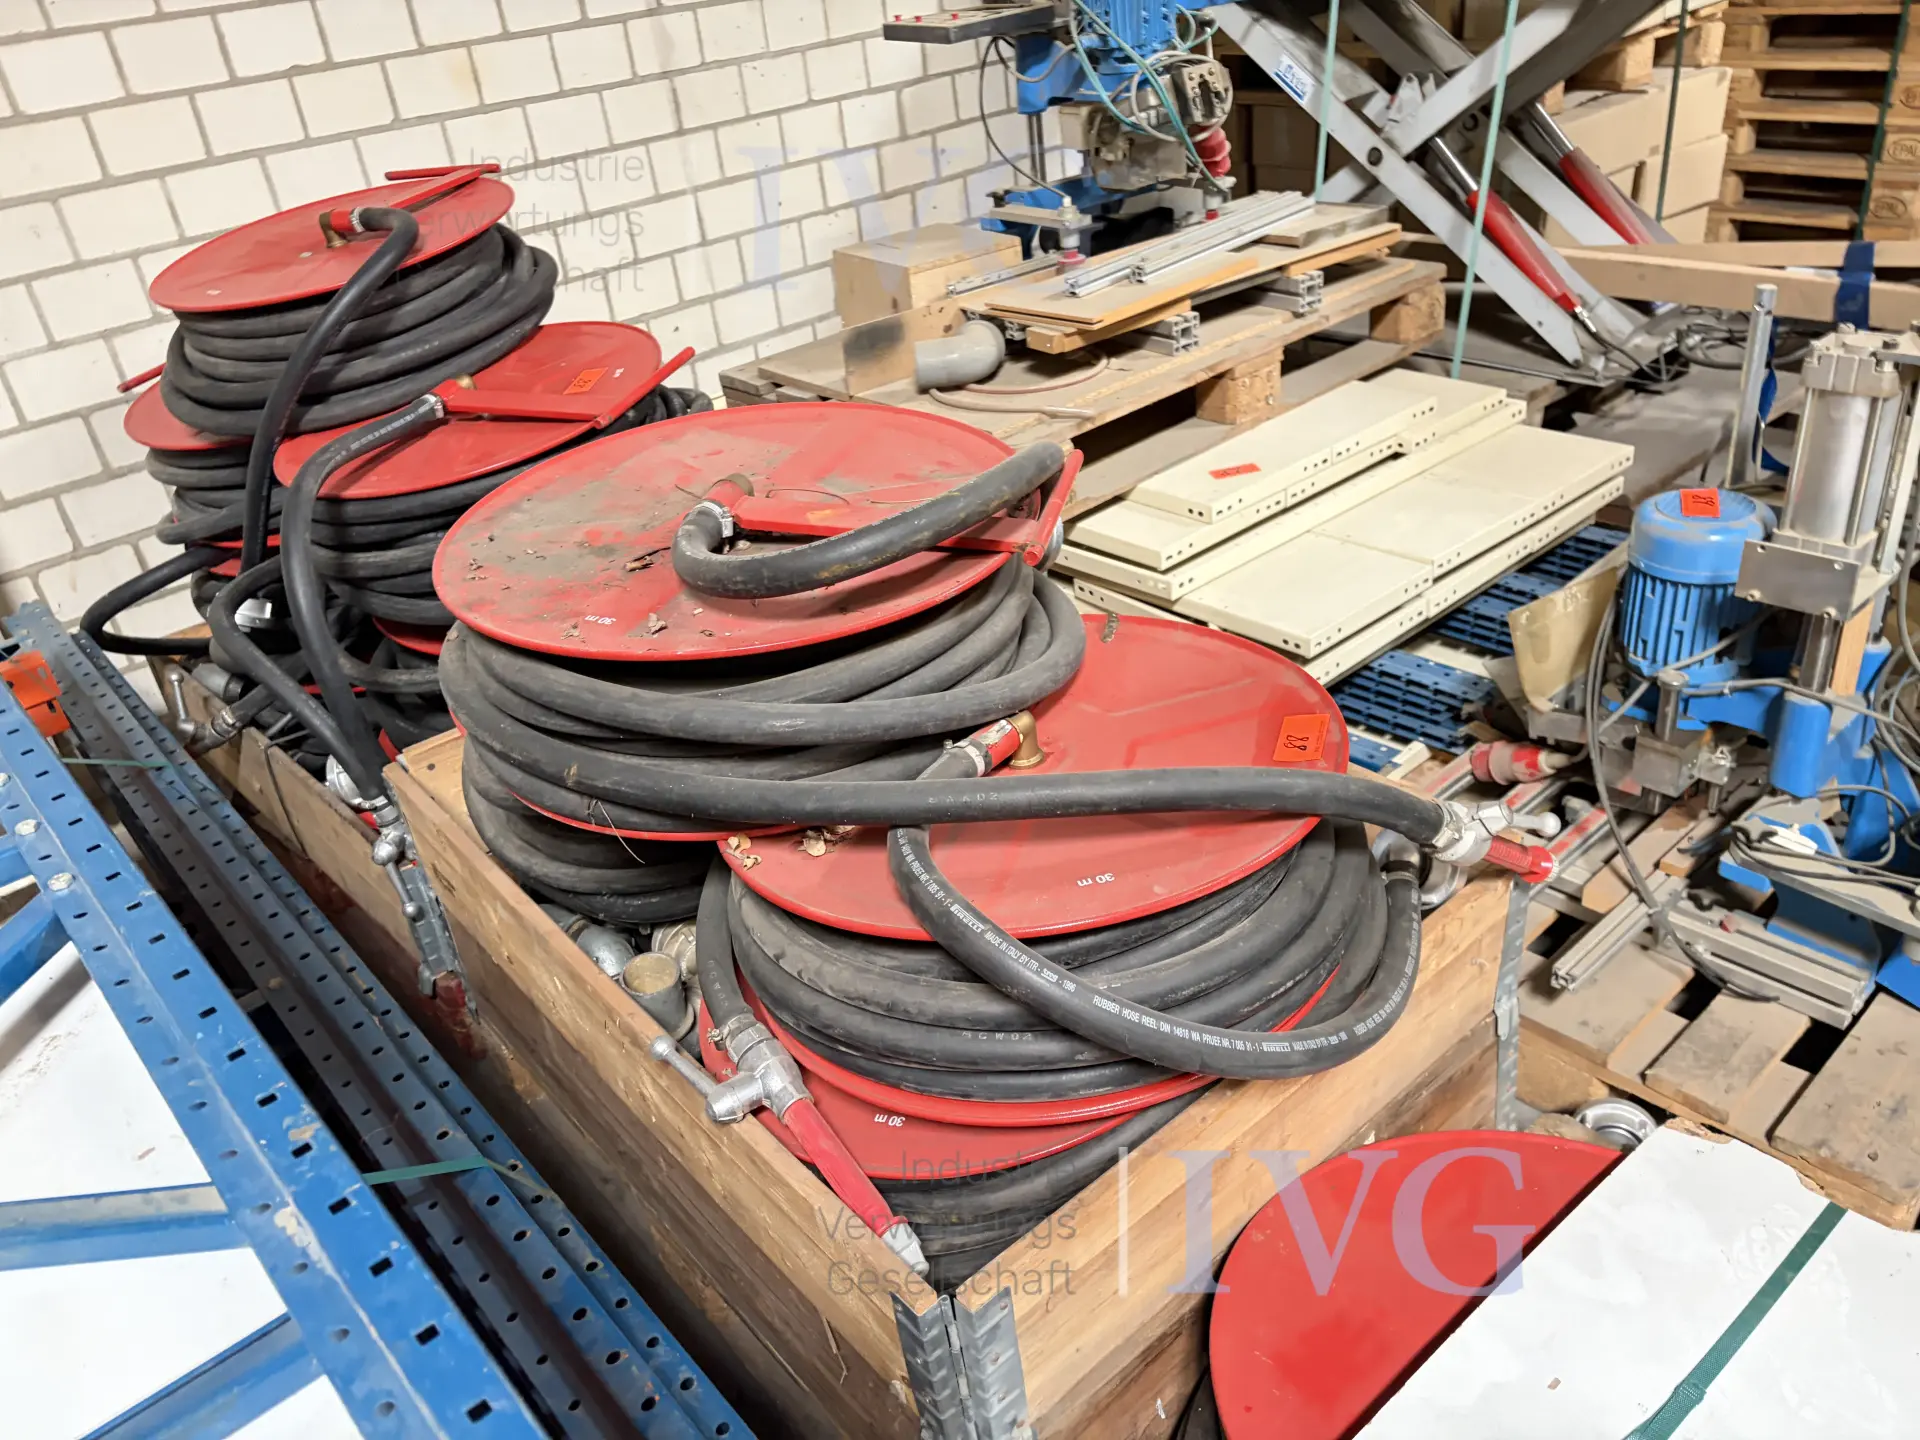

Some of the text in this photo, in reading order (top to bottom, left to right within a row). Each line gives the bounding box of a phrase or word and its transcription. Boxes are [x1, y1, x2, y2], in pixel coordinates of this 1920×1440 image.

[1076, 872, 1115, 887] 30 m
[984, 930, 1003, 948] MADE
[1005, 944, 1022, 959] ITALY
[1018, 954, 1029, 965] BY
[1093, 995, 1121, 1015] RUBBER
[1122, 1007, 1140, 1023] HOSE
[1142, 1016, 1158, 1030] REEL
[1160, 1021, 1171, 1034] DIN
[1262, 1042, 1291, 1052] PIRELLI
[874, 1113, 906, 1127] 30 m
